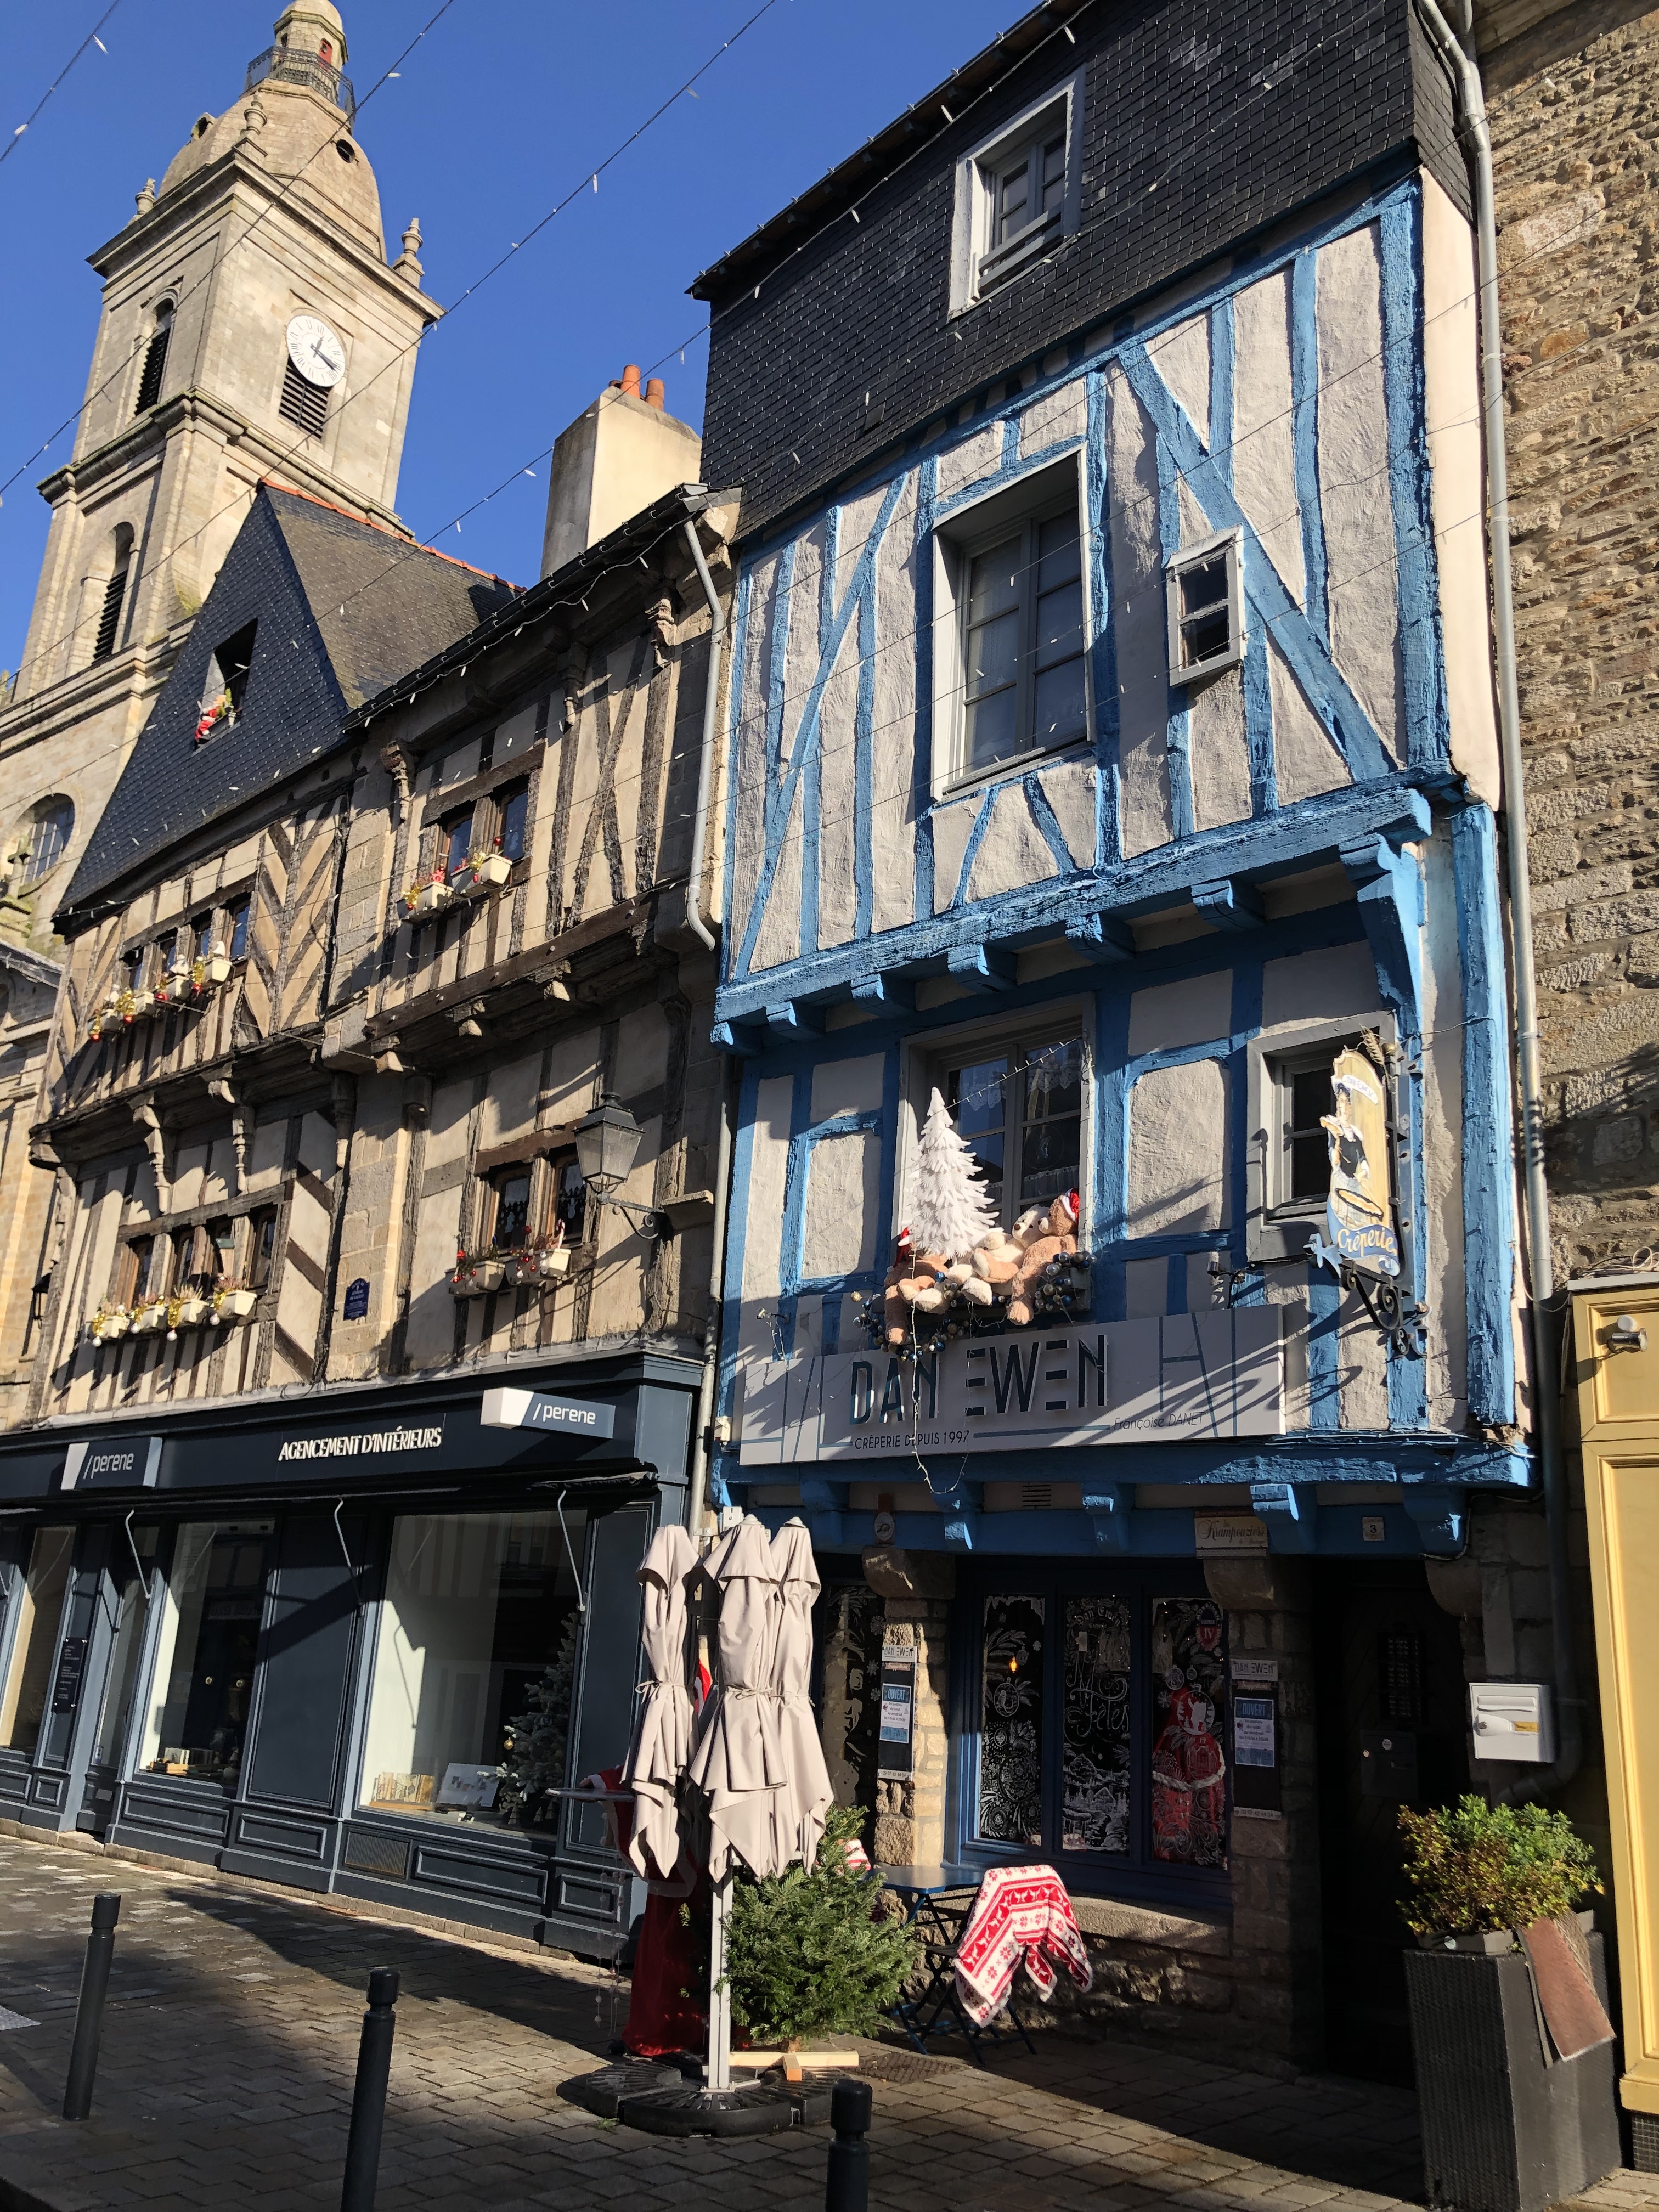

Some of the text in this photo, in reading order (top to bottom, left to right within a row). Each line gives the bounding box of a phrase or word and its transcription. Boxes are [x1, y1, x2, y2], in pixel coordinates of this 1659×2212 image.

[1337, 1227, 1398, 1258] Crêperie
[849, 1335, 1108, 1424] DAN EWEN
[1114, 1412, 1205, 1430] Françoise DANET
[278, 1426, 442, 1461] AGENCEMENT D'INTÉRIEURS
[855, 1430, 969, 1449] CRÊPERIE DEPUIS 1997
[1370, 1524, 1377, 1534] 3
[888, 1688, 905, 1701] OUVERT
[1242, 1703, 1266, 1717] OUVERT
